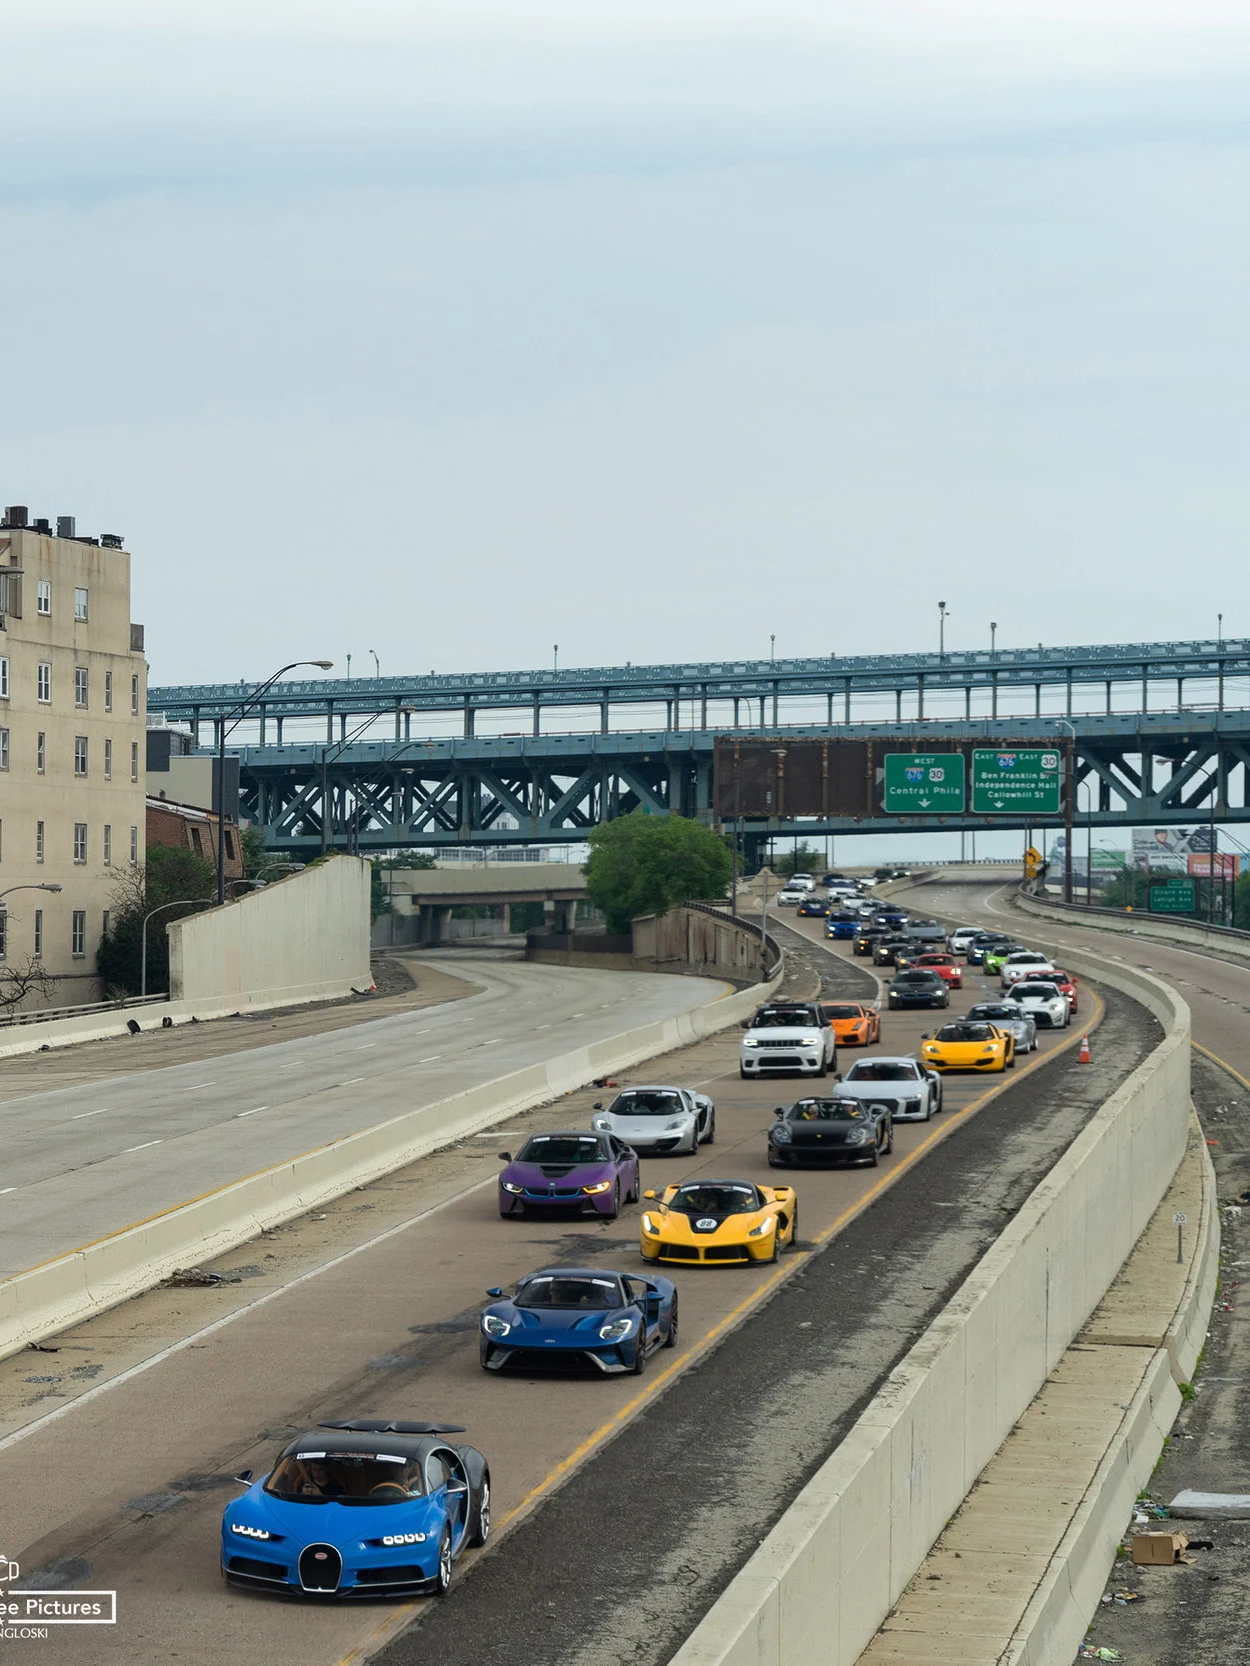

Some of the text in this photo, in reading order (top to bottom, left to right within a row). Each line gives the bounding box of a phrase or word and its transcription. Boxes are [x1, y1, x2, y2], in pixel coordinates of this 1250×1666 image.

[998, 757, 1015, 767] 676
[1042, 756, 1056, 766] 30
[907, 770, 943, 780] 676 30
[889, 786, 960, 795] Central Phila
